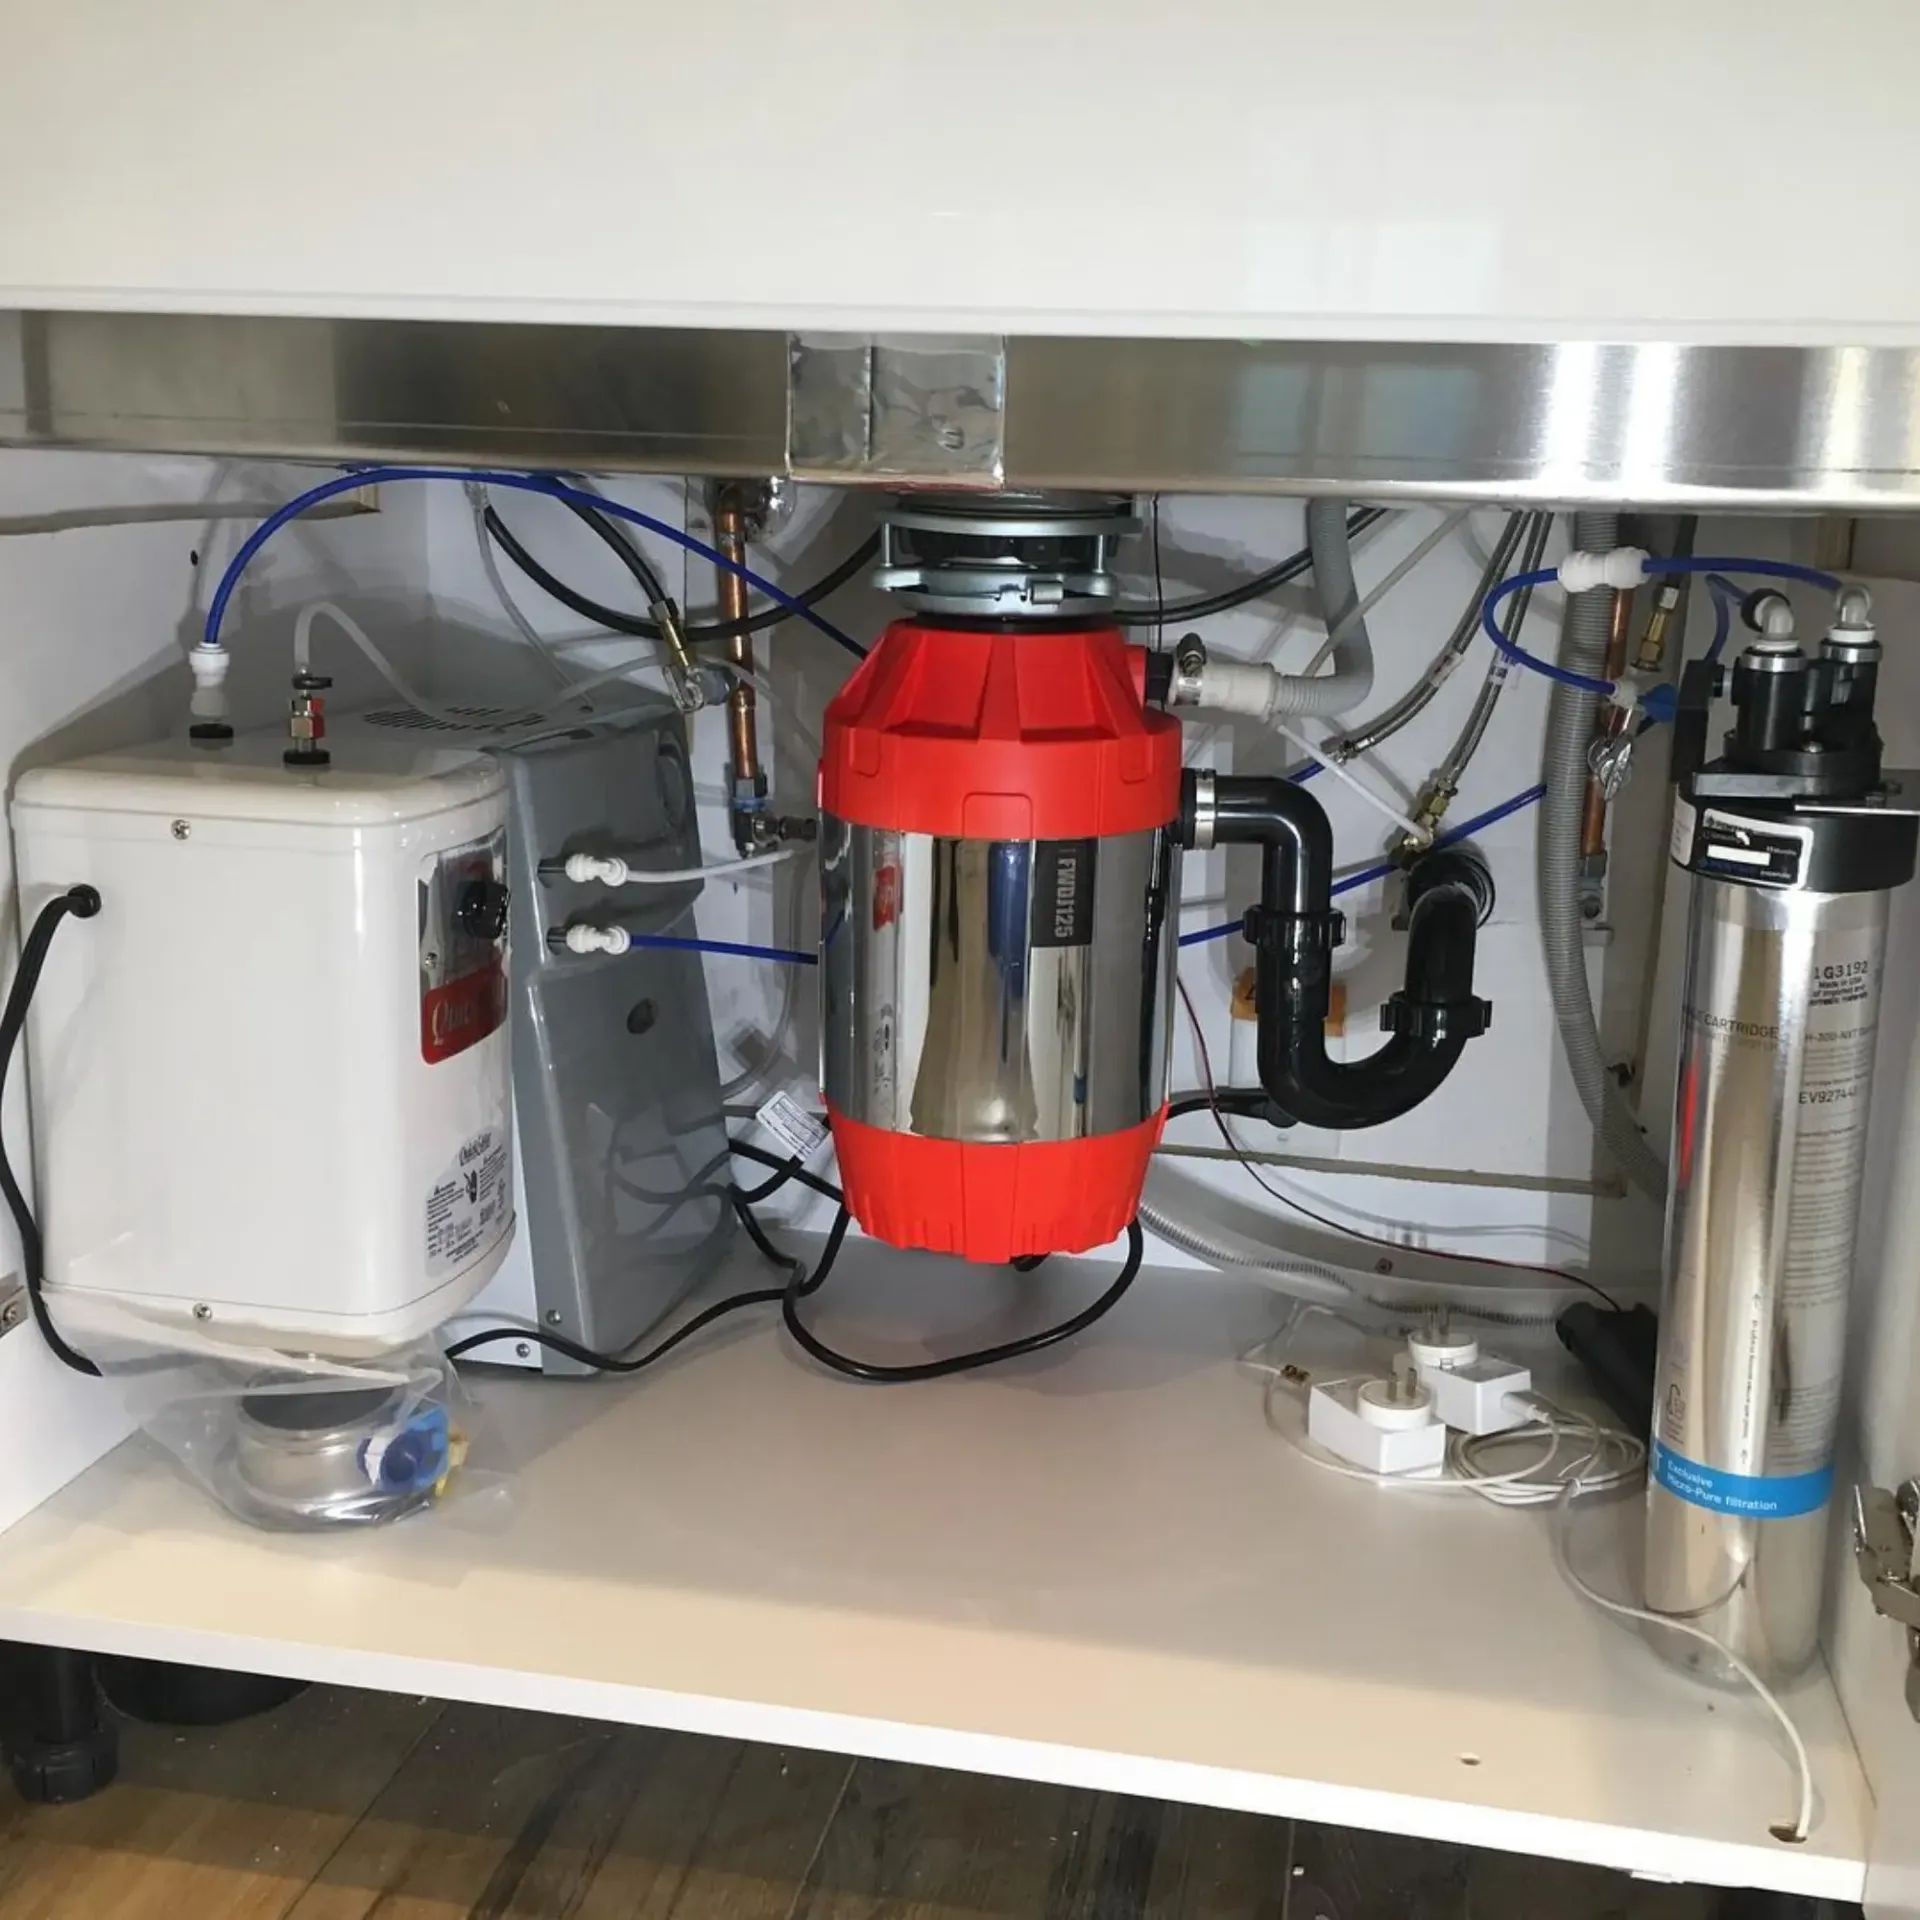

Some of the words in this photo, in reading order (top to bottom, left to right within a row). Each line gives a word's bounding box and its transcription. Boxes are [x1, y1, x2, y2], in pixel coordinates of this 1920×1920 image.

[1813, 960, 1868, 980] 1G3192
[1704, 1013, 1780, 1041] CARTRIDGE
[1667, 1460, 1713, 1489] Exclusive
[1725, 1496, 1778, 1511] filtration
